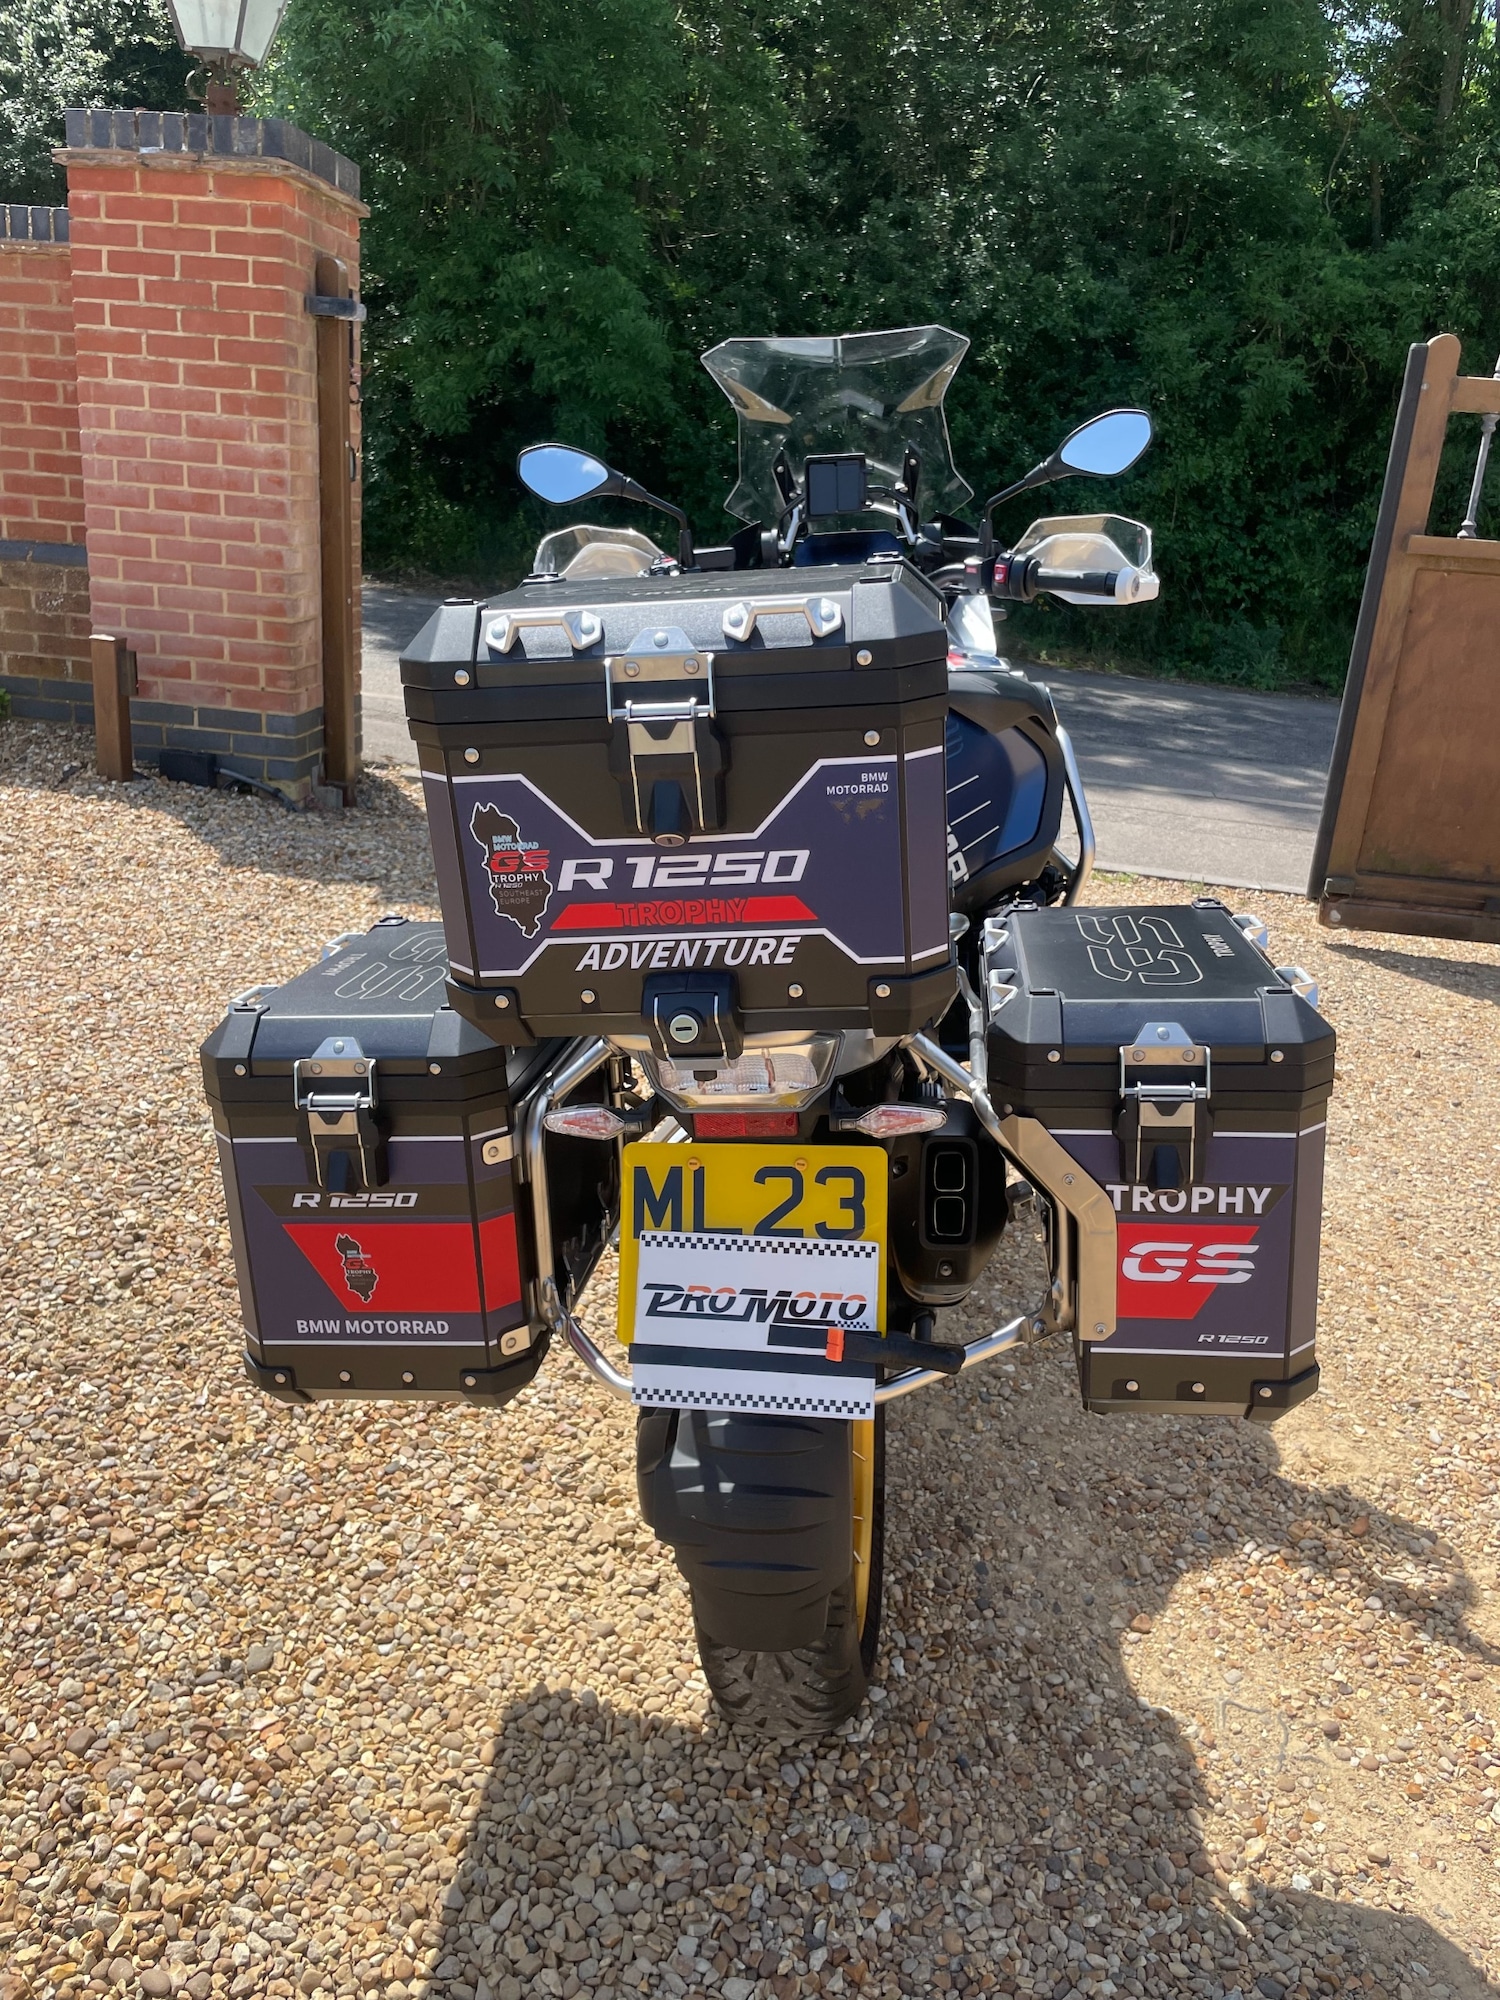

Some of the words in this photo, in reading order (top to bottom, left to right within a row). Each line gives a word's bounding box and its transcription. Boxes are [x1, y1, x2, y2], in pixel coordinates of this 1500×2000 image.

[861, 772, 888, 782] BMW
[826, 783, 889, 795] MOTORRAD
[492, 835, 512, 843] BMW
[493, 842, 539, 850] MOTORRAD
[490, 850, 550, 872] GS
[493, 873, 539, 882] TROPHY
[557, 857, 614, 892] R
[625, 849, 811, 889] 1250
[500, 889, 543, 897] SOUTHEAST
[616, 898, 750, 927] TROPHY
[574, 936, 801, 972] ADVENTURE
[292, 1193, 321, 1208] R
[329, 1193, 419, 1208] 1250
[1105, 1184, 1272, 1214] TROPHY
[1121, 1241, 1260, 1284] GS
[296, 1319, 340, 1334] BMW
[345, 1319, 449, 1335] MOTORRAD
[1197, 1334, 1215, 1343] R
[1217, 1334, 1269, 1345] 1250
